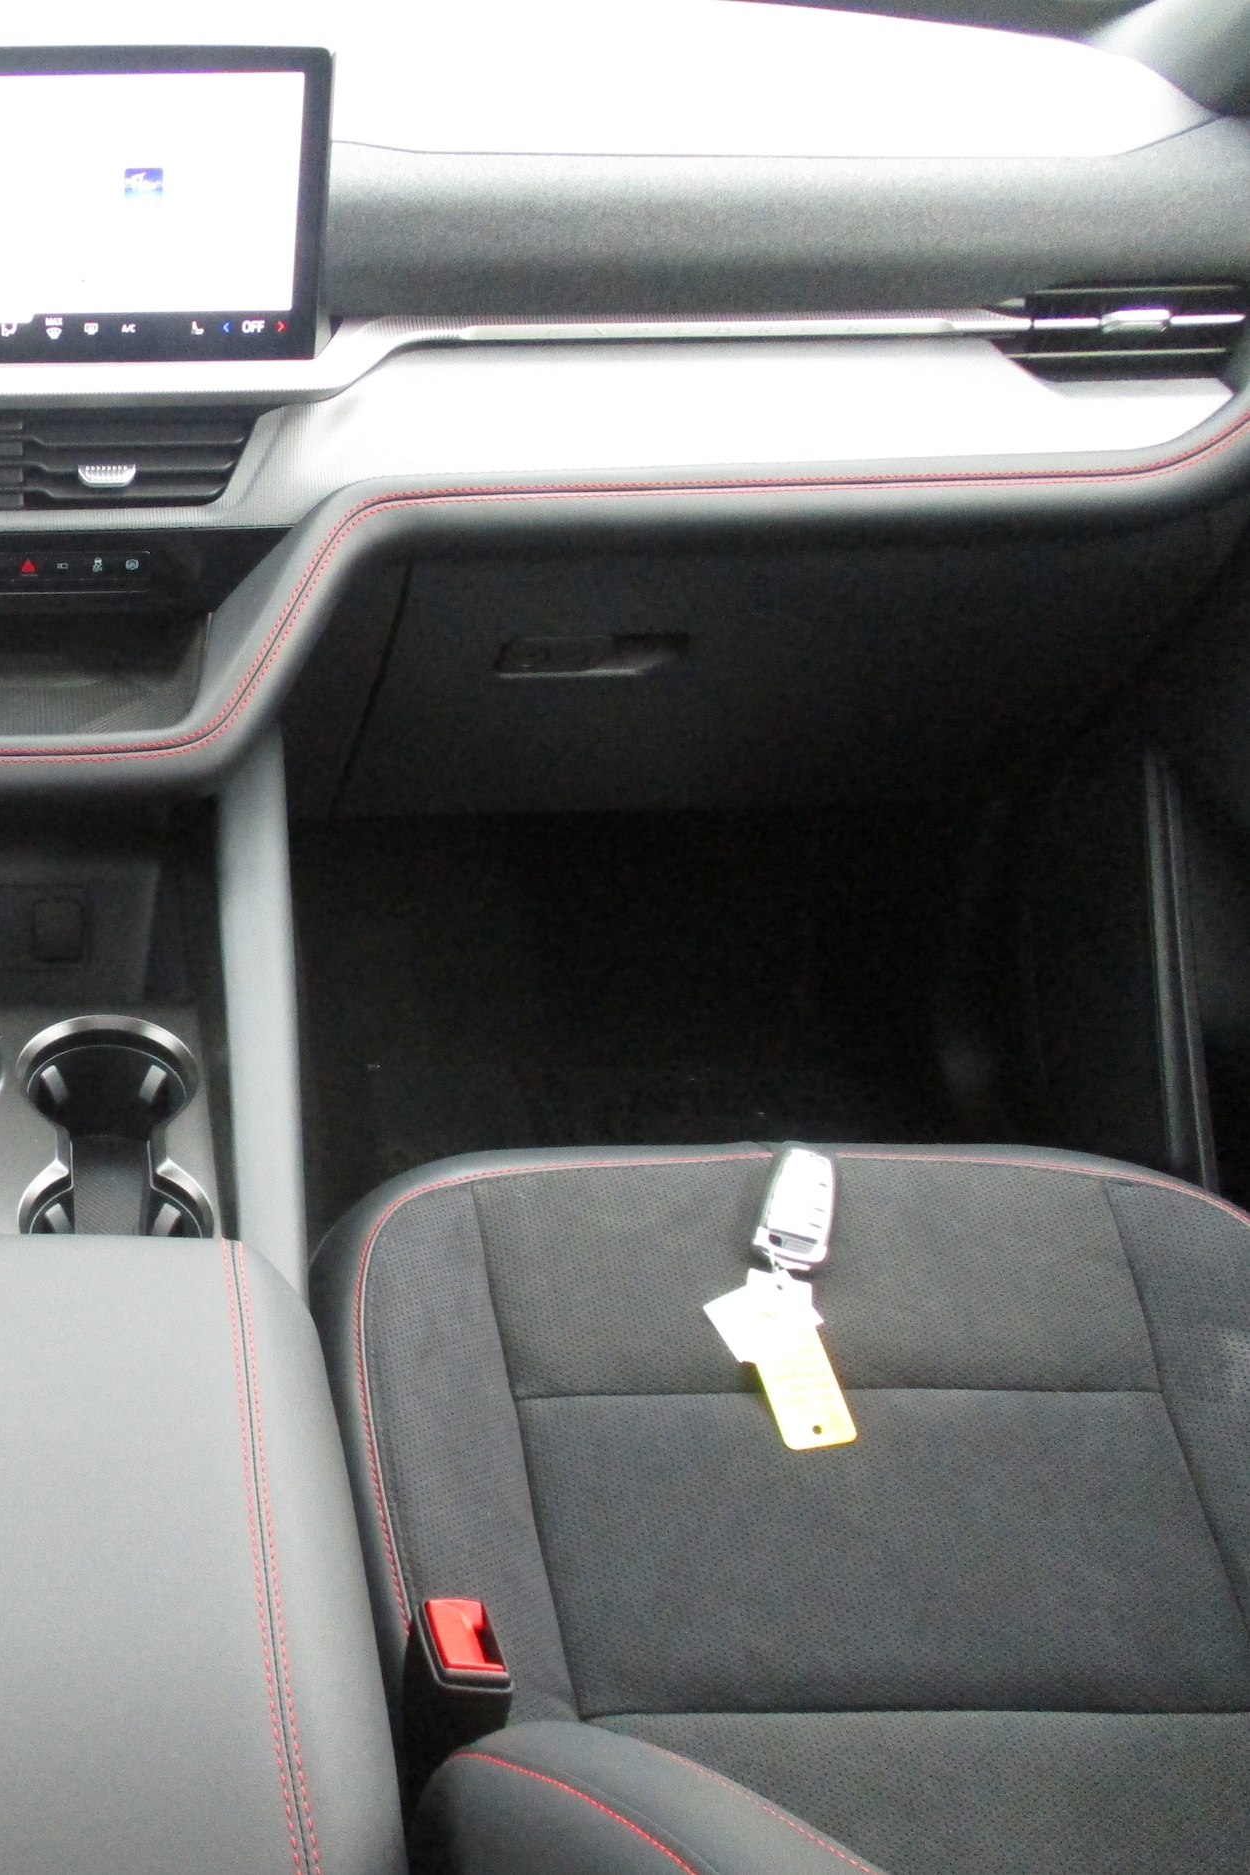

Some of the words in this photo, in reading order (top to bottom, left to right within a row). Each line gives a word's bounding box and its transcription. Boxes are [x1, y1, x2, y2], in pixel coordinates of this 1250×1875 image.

[45, 317, 63, 326] MAX
[241, 320, 265, 333] OFF
[121, 323, 136, 333] A/C
